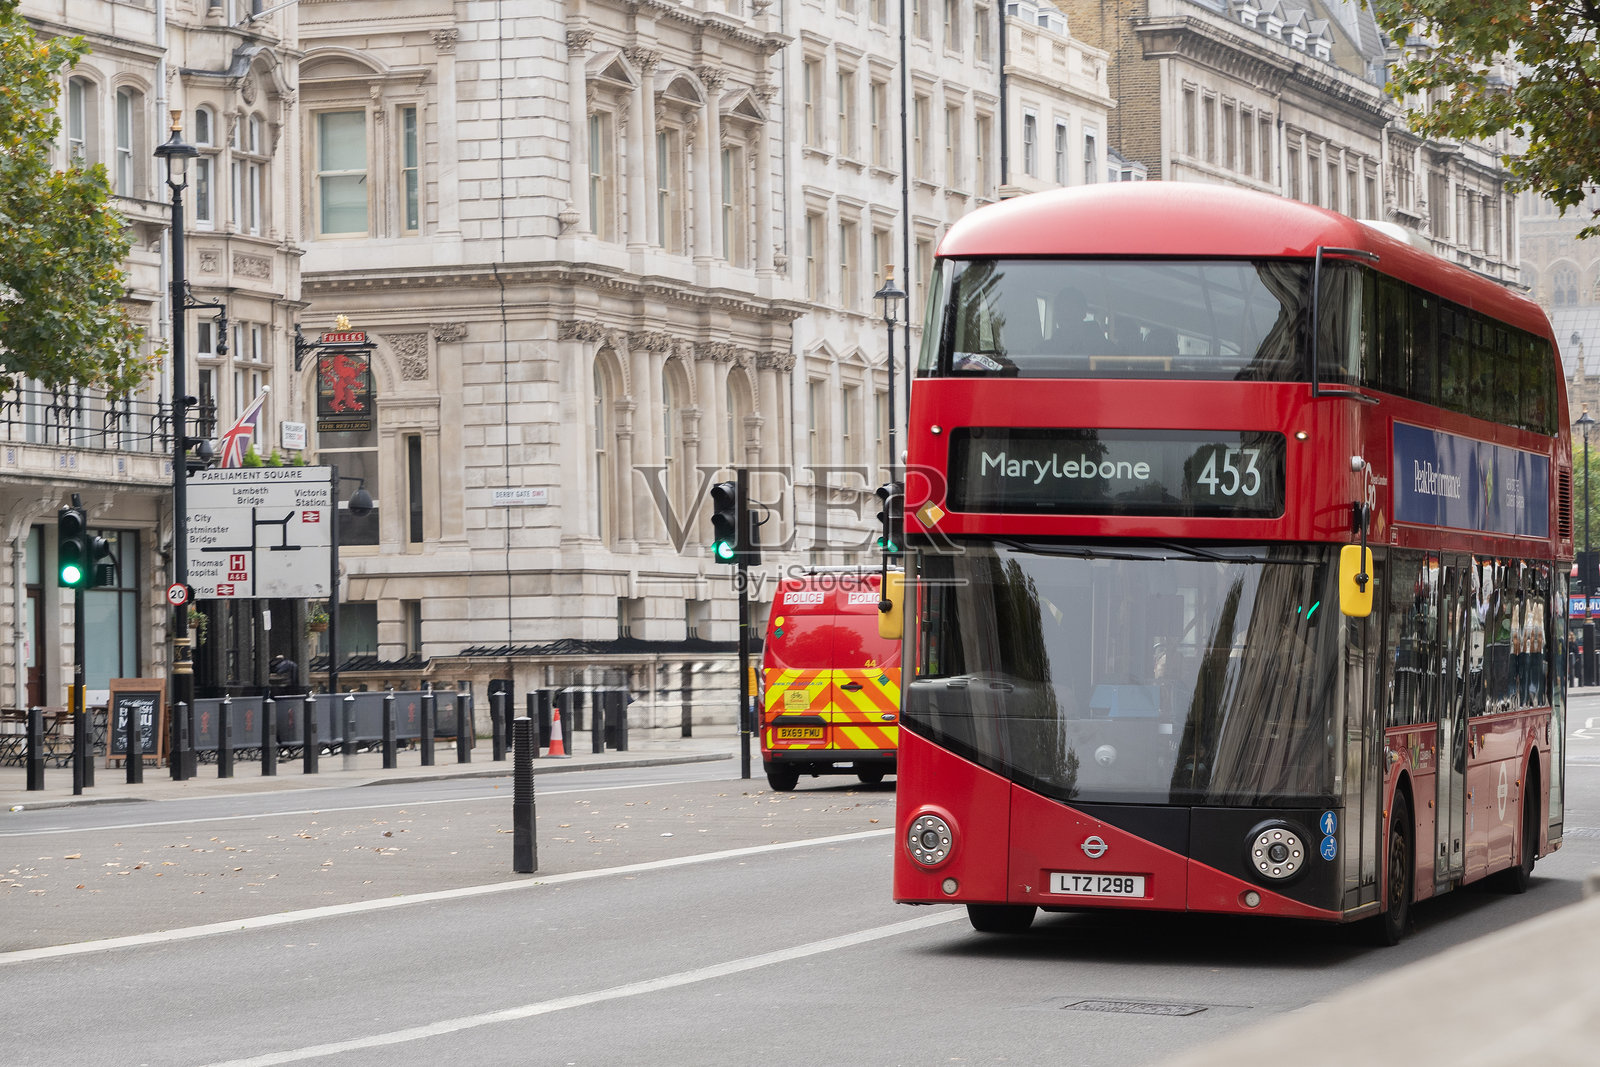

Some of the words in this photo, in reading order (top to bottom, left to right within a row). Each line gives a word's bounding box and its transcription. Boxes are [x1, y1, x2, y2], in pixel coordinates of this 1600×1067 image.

[202, 472, 260, 480] PARLIAMENT
[264, 471, 302, 479] SQUARE
[981, 451, 1150, 484] Marylebone
[1197, 449, 1261, 496] 453
[295, 489, 327, 497] Victoria
[238, 497, 264, 505] Bridge
[194, 514, 211, 523] City
[186, 526, 229, 534] estminster
[190, 536, 217, 544] Bridge
[232, 555, 243, 570] H
[171, 590, 184, 598] 20
[785, 593, 822, 603] POLICE
[850, 594, 880, 603] POLIC
[864, 659, 876, 668] 44
[782, 729, 802, 737] BX69
[804, 729, 820, 737] FMU
[1061, 876, 1092, 891] LTZ
[1097, 877, 1133, 893] 1298
